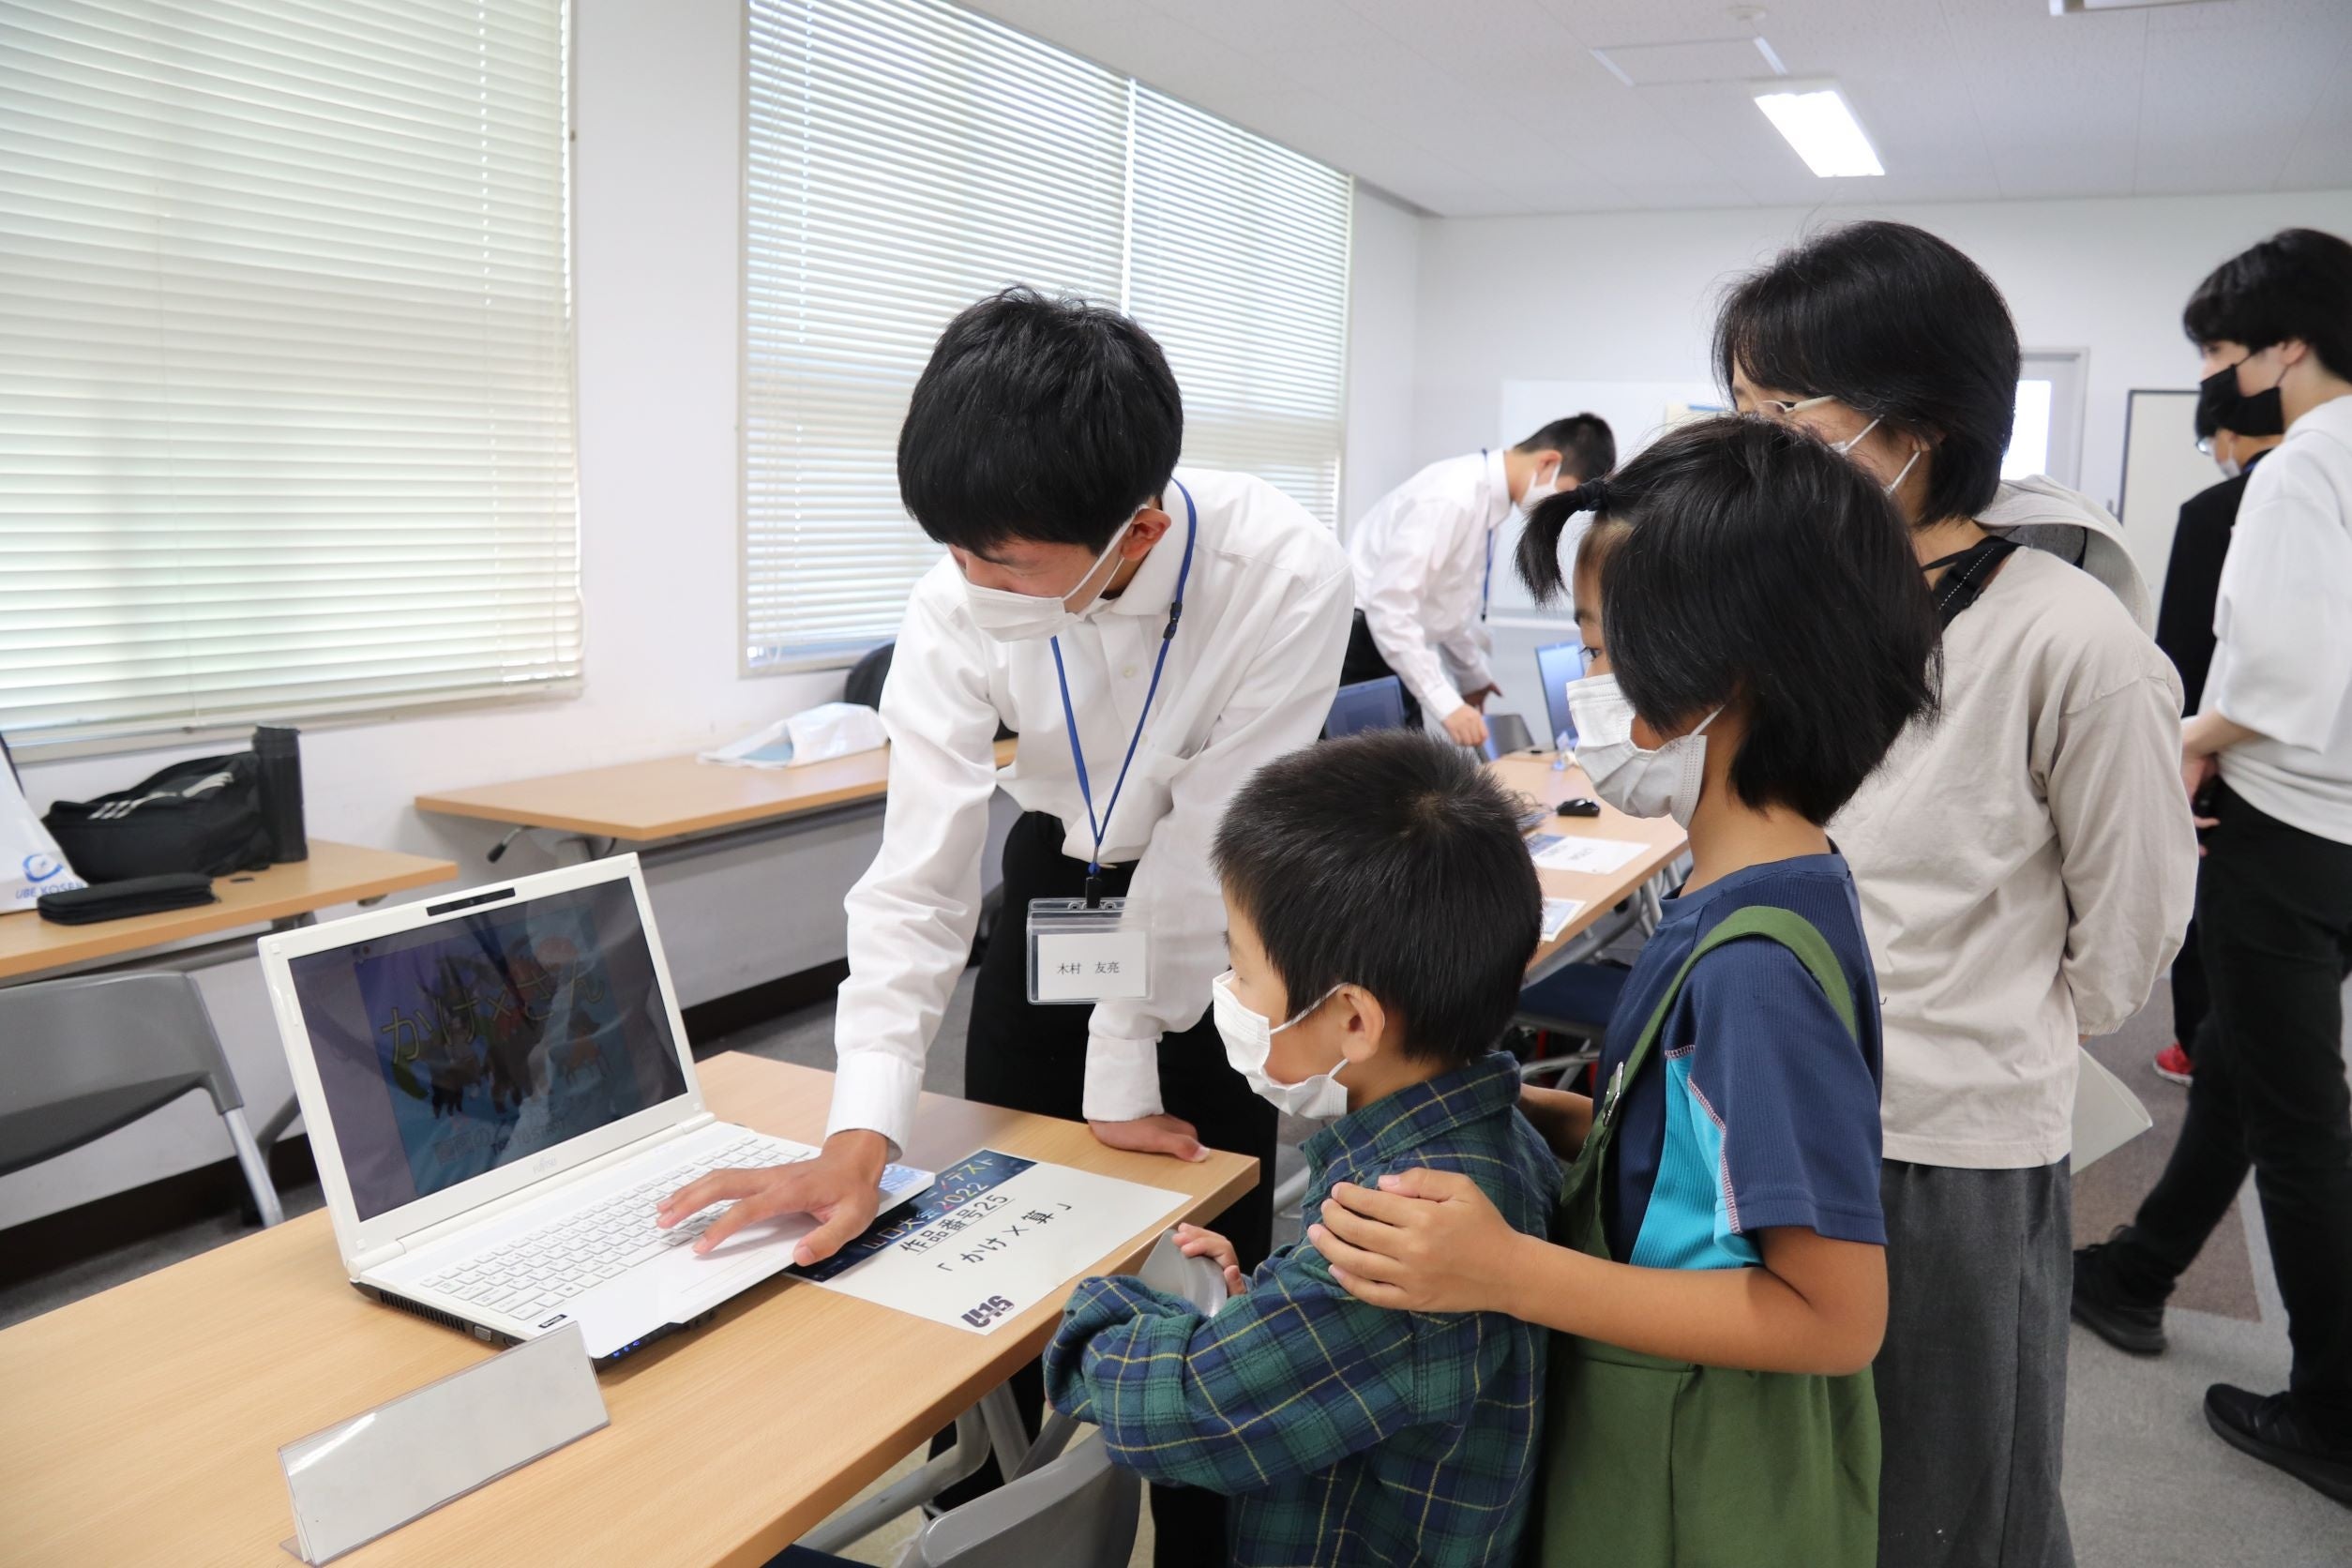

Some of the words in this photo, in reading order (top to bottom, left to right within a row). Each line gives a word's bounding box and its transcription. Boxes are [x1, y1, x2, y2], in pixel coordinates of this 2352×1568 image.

[15, 887, 37, 899] UBE
[1057, 962, 1080, 975] 木村
[1094, 961, 1120, 974] 友亮
[899, 1194, 1008, 1253] 作品番号25
